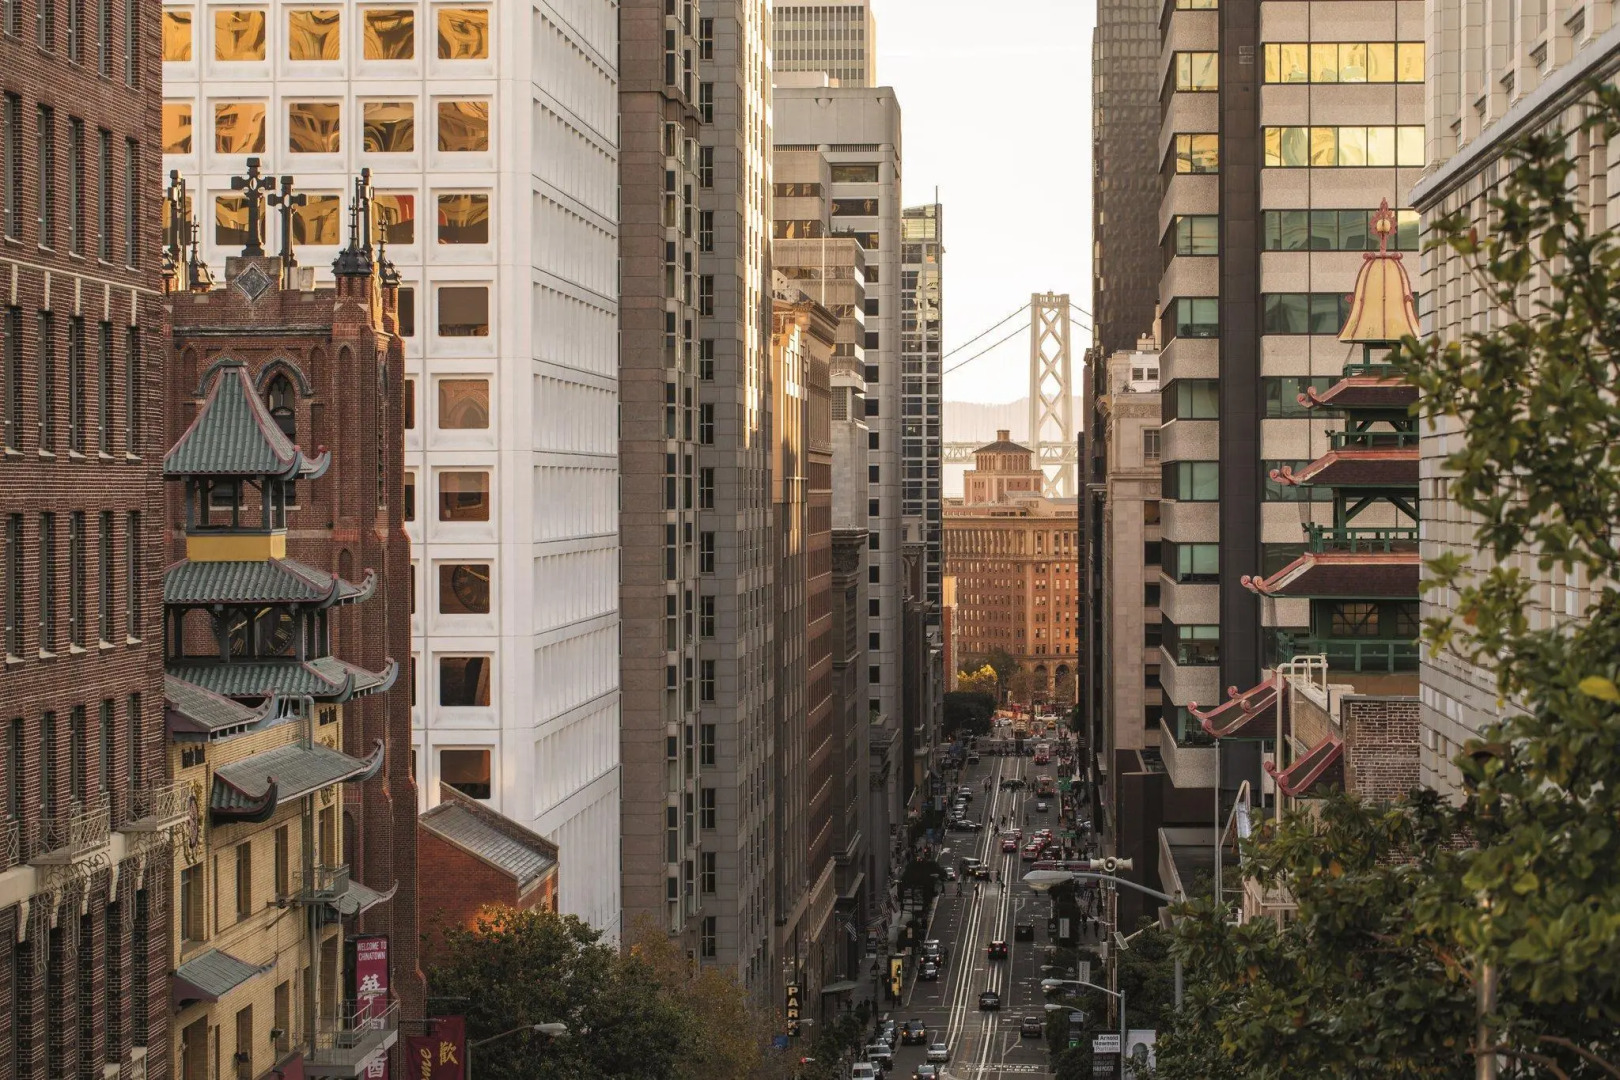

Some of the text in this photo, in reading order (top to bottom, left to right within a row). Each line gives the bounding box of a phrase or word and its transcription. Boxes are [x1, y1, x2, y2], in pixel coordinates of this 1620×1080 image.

[357, 941, 387, 951] WELCOME TO
[358, 952, 386, 961] CHINATOWN
[788, 986, 799, 1029] PARK
